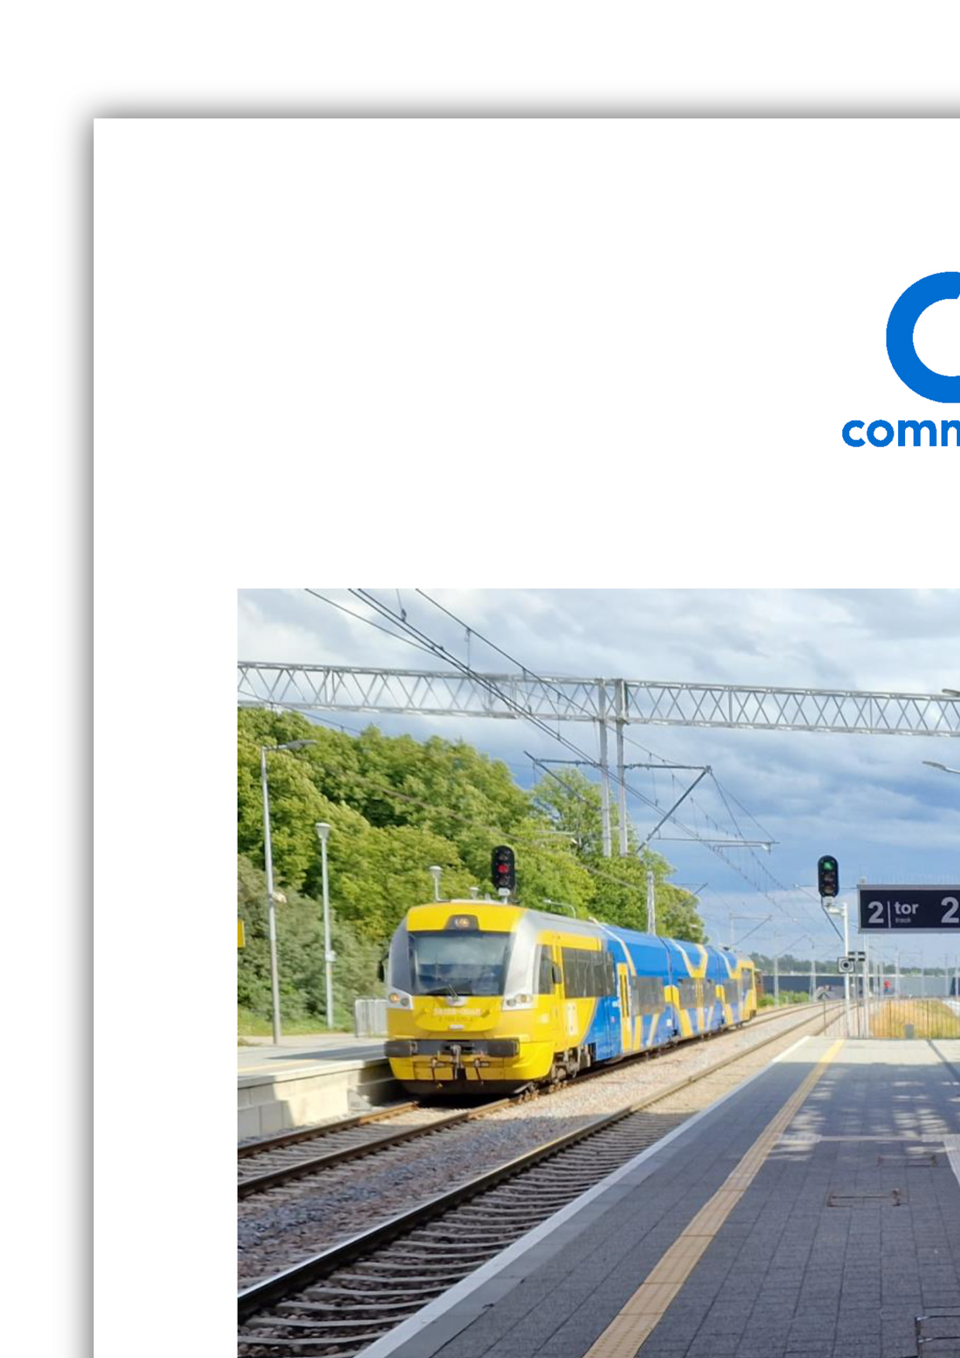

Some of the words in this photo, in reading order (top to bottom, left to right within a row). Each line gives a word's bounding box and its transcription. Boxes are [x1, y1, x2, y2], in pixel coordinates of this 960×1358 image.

[868, 901, 884, 924] 2
[894, 901, 919, 915] tor
[941, 896, 960, 924] 2
